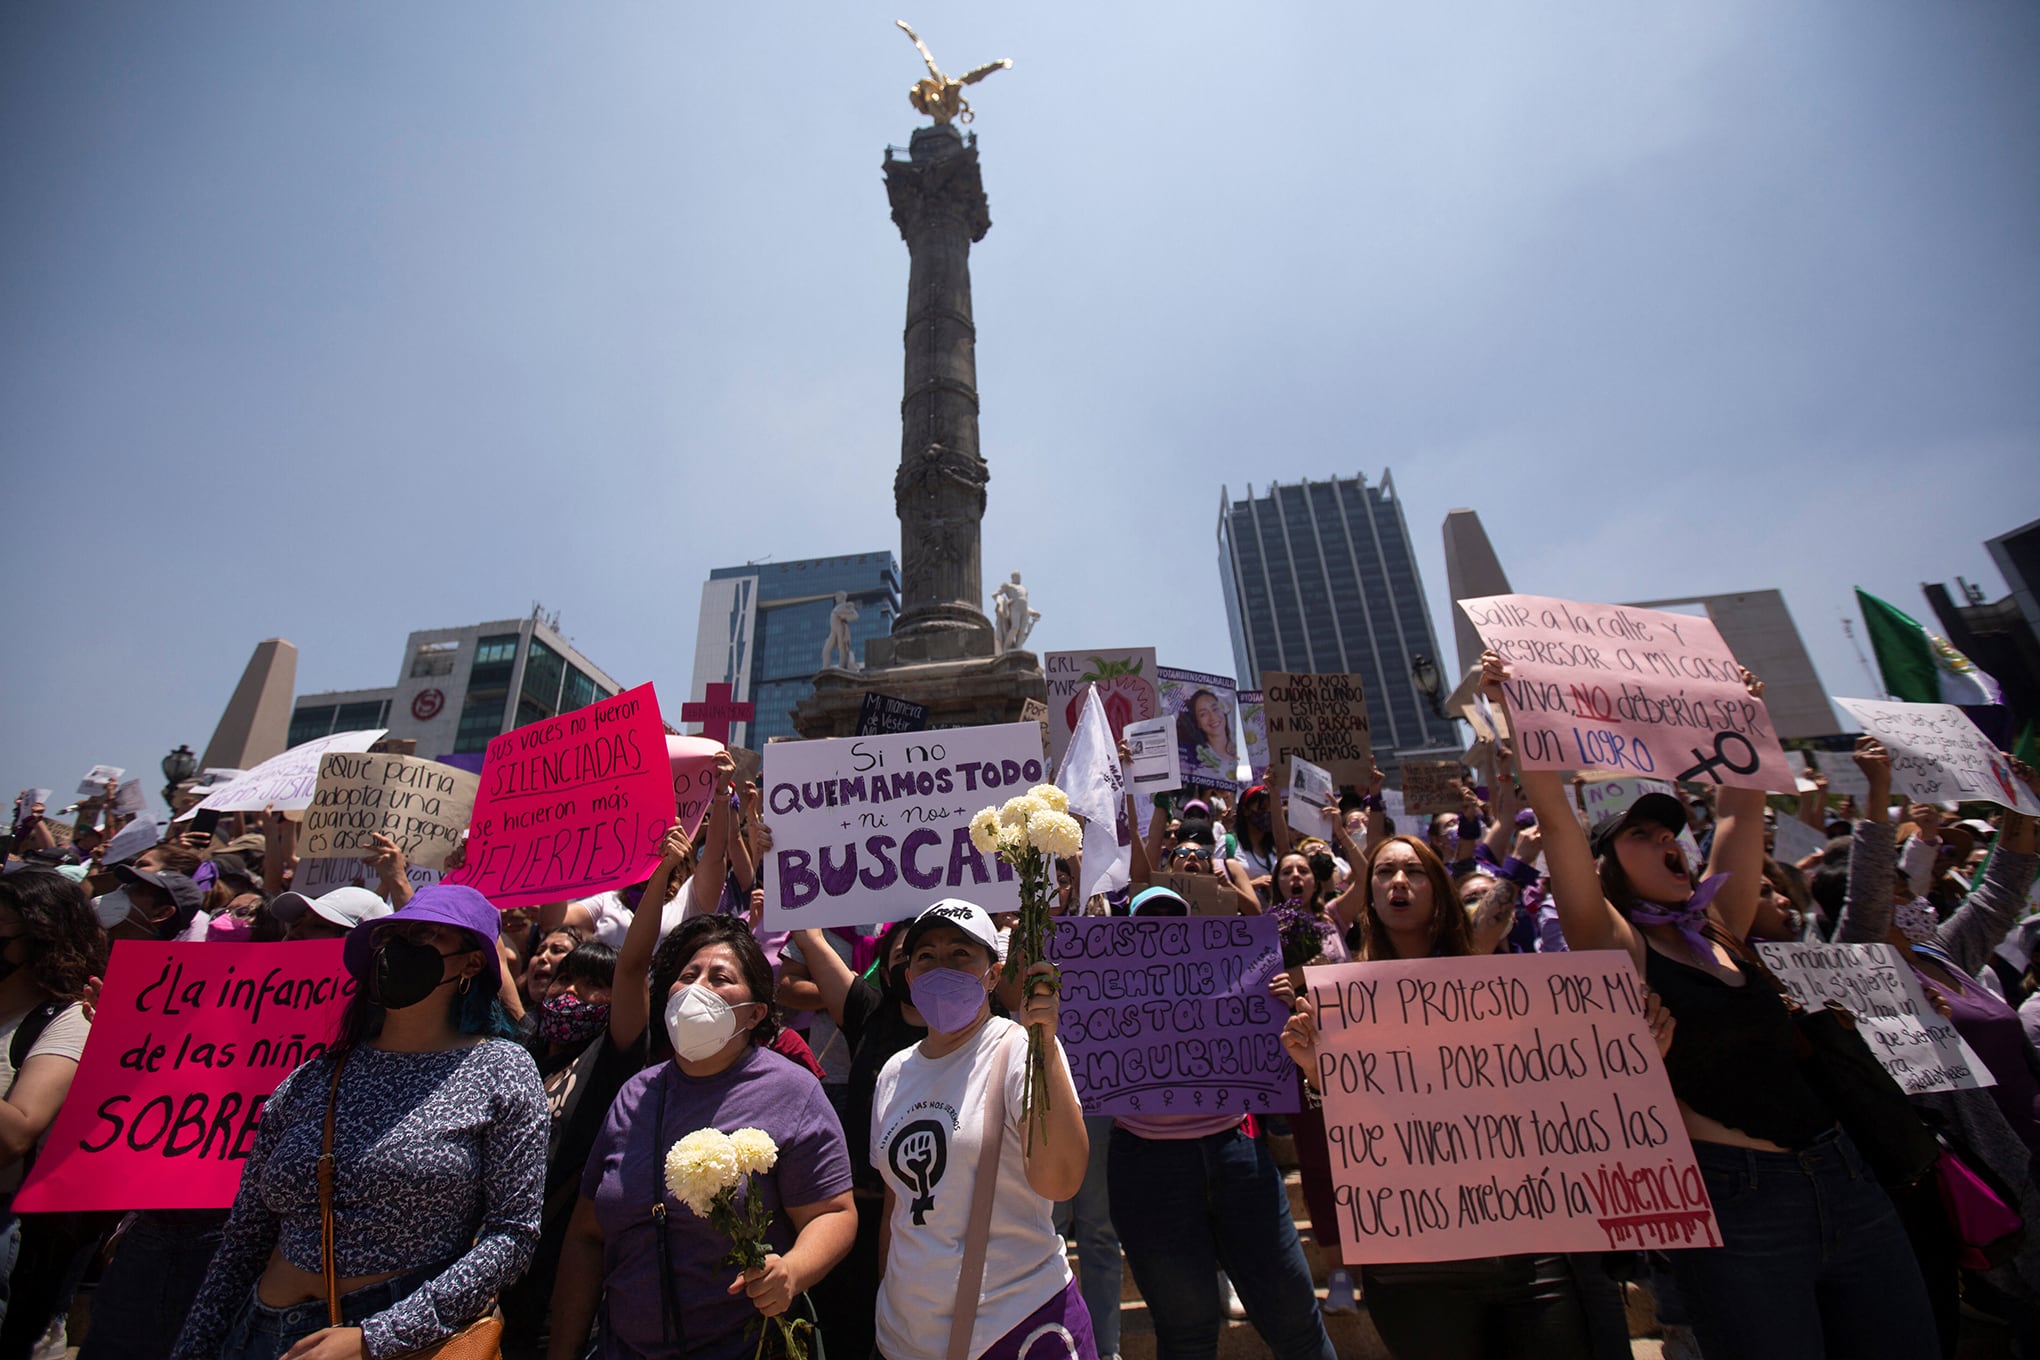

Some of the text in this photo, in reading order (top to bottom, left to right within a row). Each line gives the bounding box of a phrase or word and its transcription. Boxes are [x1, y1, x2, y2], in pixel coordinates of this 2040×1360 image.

[1541, 610, 1560, 631] a
[1561, 604, 1594, 635] la
[1599, 610, 1653, 642] calle
[1047, 656, 1081, 673] GRL
[1290, 675, 1349, 688] NO NOS
[1617, 648, 1643, 674] a
[1643, 650, 1678, 678] mi
[1679, 656, 1742, 684] casa
[1046, 680, 1080, 697] PWR
[1269, 686, 1318, 702] CUIDAN
[1569, 682, 1613, 720] NO
[866, 693, 923, 719] Mi manera
[867, 711, 879, 727] de
[1290, 702, 1350, 716] ESTAMOS
[488, 698, 640, 764] sus voces no fueron
[1270, 716, 1368, 732] NI NOS BUSCAN
[1304, 732, 1353, 747] CUANDO
[490, 729, 642, 797] SILENCIADAS
[851, 742, 947, 772] Si no
[1523, 729, 1565, 763] un
[383, 761, 455, 795] patria
[956, 758, 1043, 792] TODO
[314, 785, 441, 816] adopta una
[473, 785, 629, 839] se hicieron más
[858, 805, 951, 829] ni nos
[309, 810, 460, 847] cuando la propia
[309, 834, 328, 853] es
[1049, 919, 1254, 960] BASTA DE
[1762, 945, 1788, 970] Si
[136, 956, 360, 1024] ¿La infancia
[1313, 979, 1378, 1031] HOY
[1547, 974, 1604, 1015] POR
[1058, 995, 1272, 1045] BASTA DE
[120, 1033, 327, 1072] de las niña
[1874, 1030, 1905, 1056] que
[1318, 1050, 1384, 1097] POR
[1438, 1042, 1495, 1090] POR
[1591, 1024, 1649, 1080] las
[1328, 1121, 1387, 1169] que
[1394, 1112, 1467, 1166] viven
[1532, 1101, 1610, 1155] todas
[1613, 1093, 1669, 1149] las
[1334, 1184, 1400, 1243] que
[1400, 1187, 1450, 1237] nos
[1560, 1171, 1592, 1218] la
[1581, 1158, 1711, 1217] violencia
